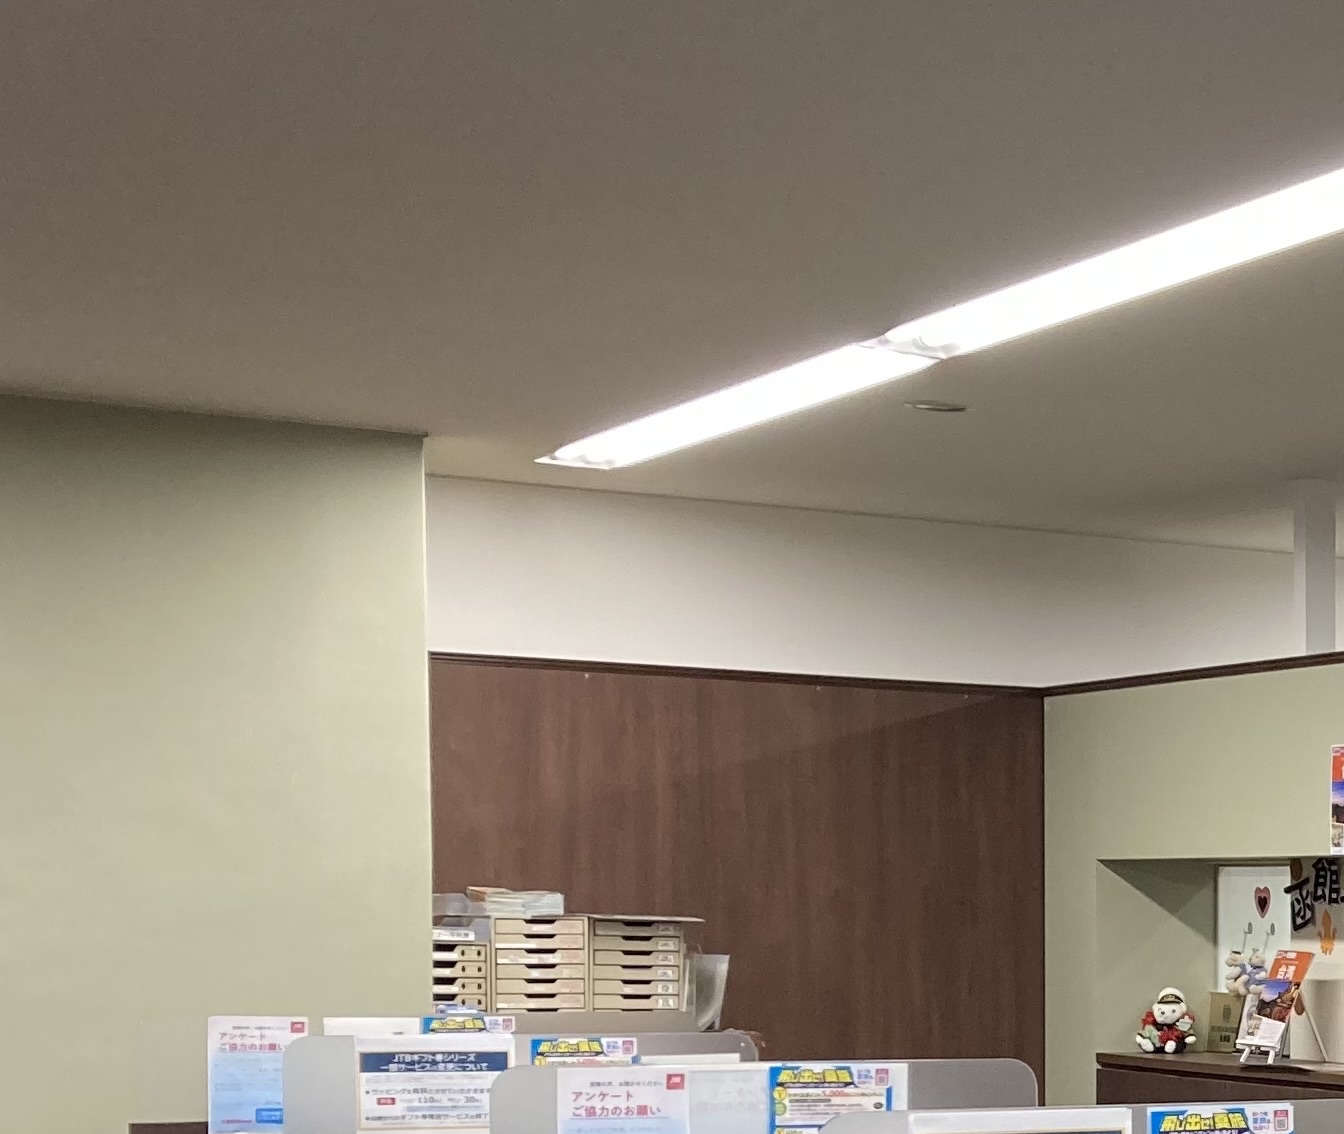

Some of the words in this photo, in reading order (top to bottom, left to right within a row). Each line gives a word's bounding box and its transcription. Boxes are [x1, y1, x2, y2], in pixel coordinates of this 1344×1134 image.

[571, 1091, 634, 1102] アンケート
[572, 1105, 662, 1117] ご協力のお願い
